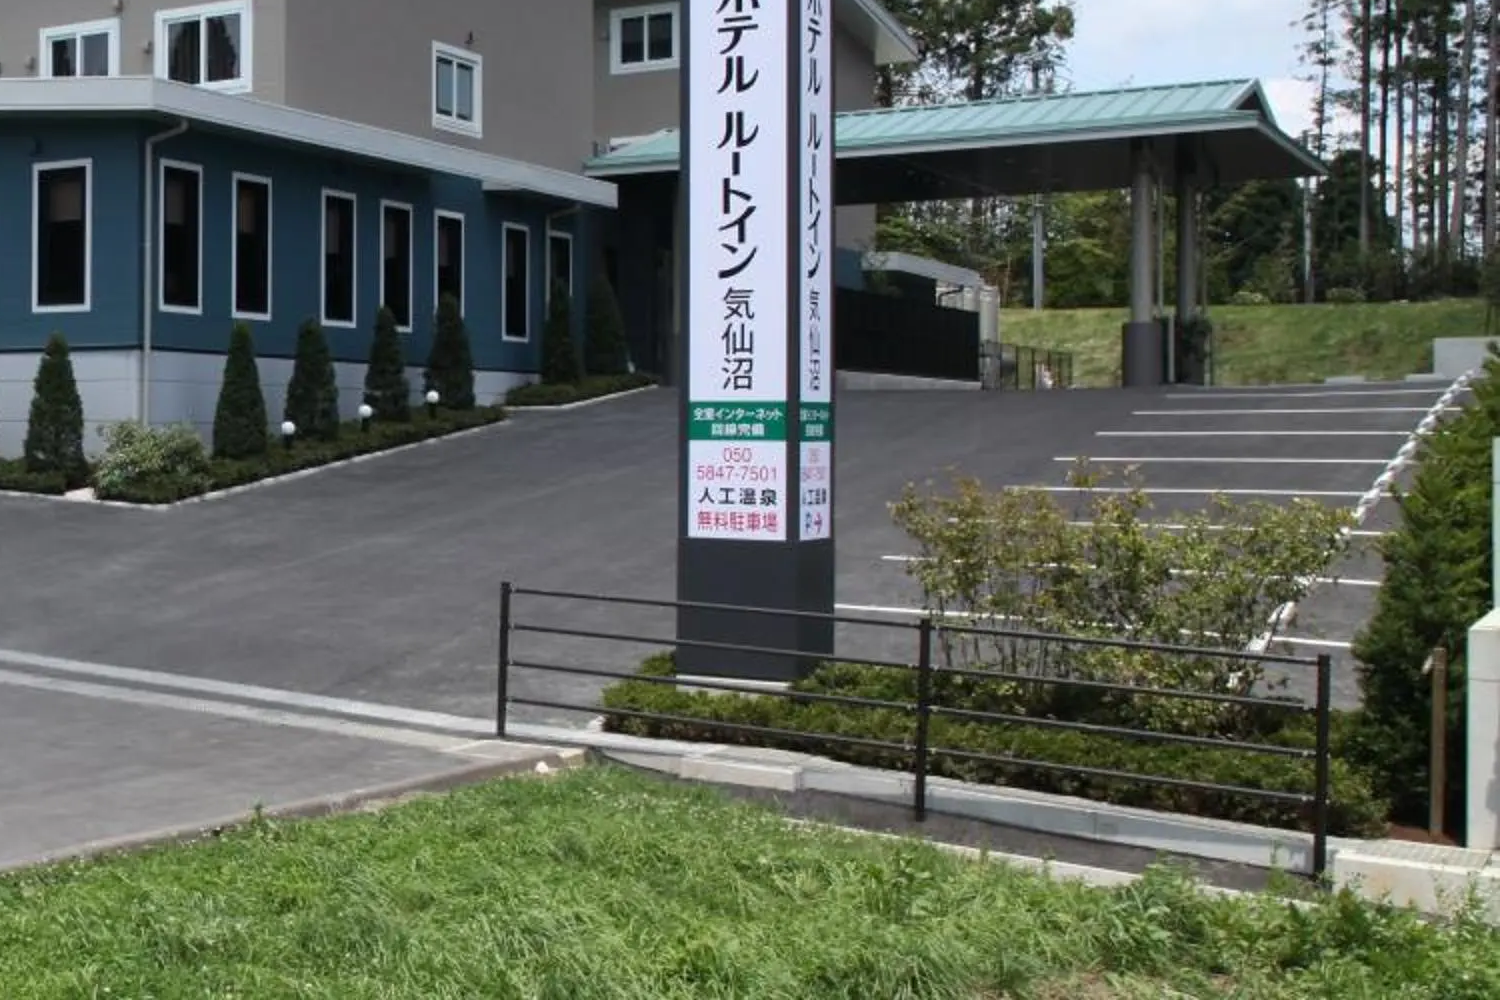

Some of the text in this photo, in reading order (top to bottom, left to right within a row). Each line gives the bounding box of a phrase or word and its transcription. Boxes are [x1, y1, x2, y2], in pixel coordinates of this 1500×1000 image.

[721, 286, 755, 391] 気仙沼
[723, 447, 752, 463] 050
[698, 487, 778, 506] 人工温泉
[697, 511, 779, 533] 無料駐車場
